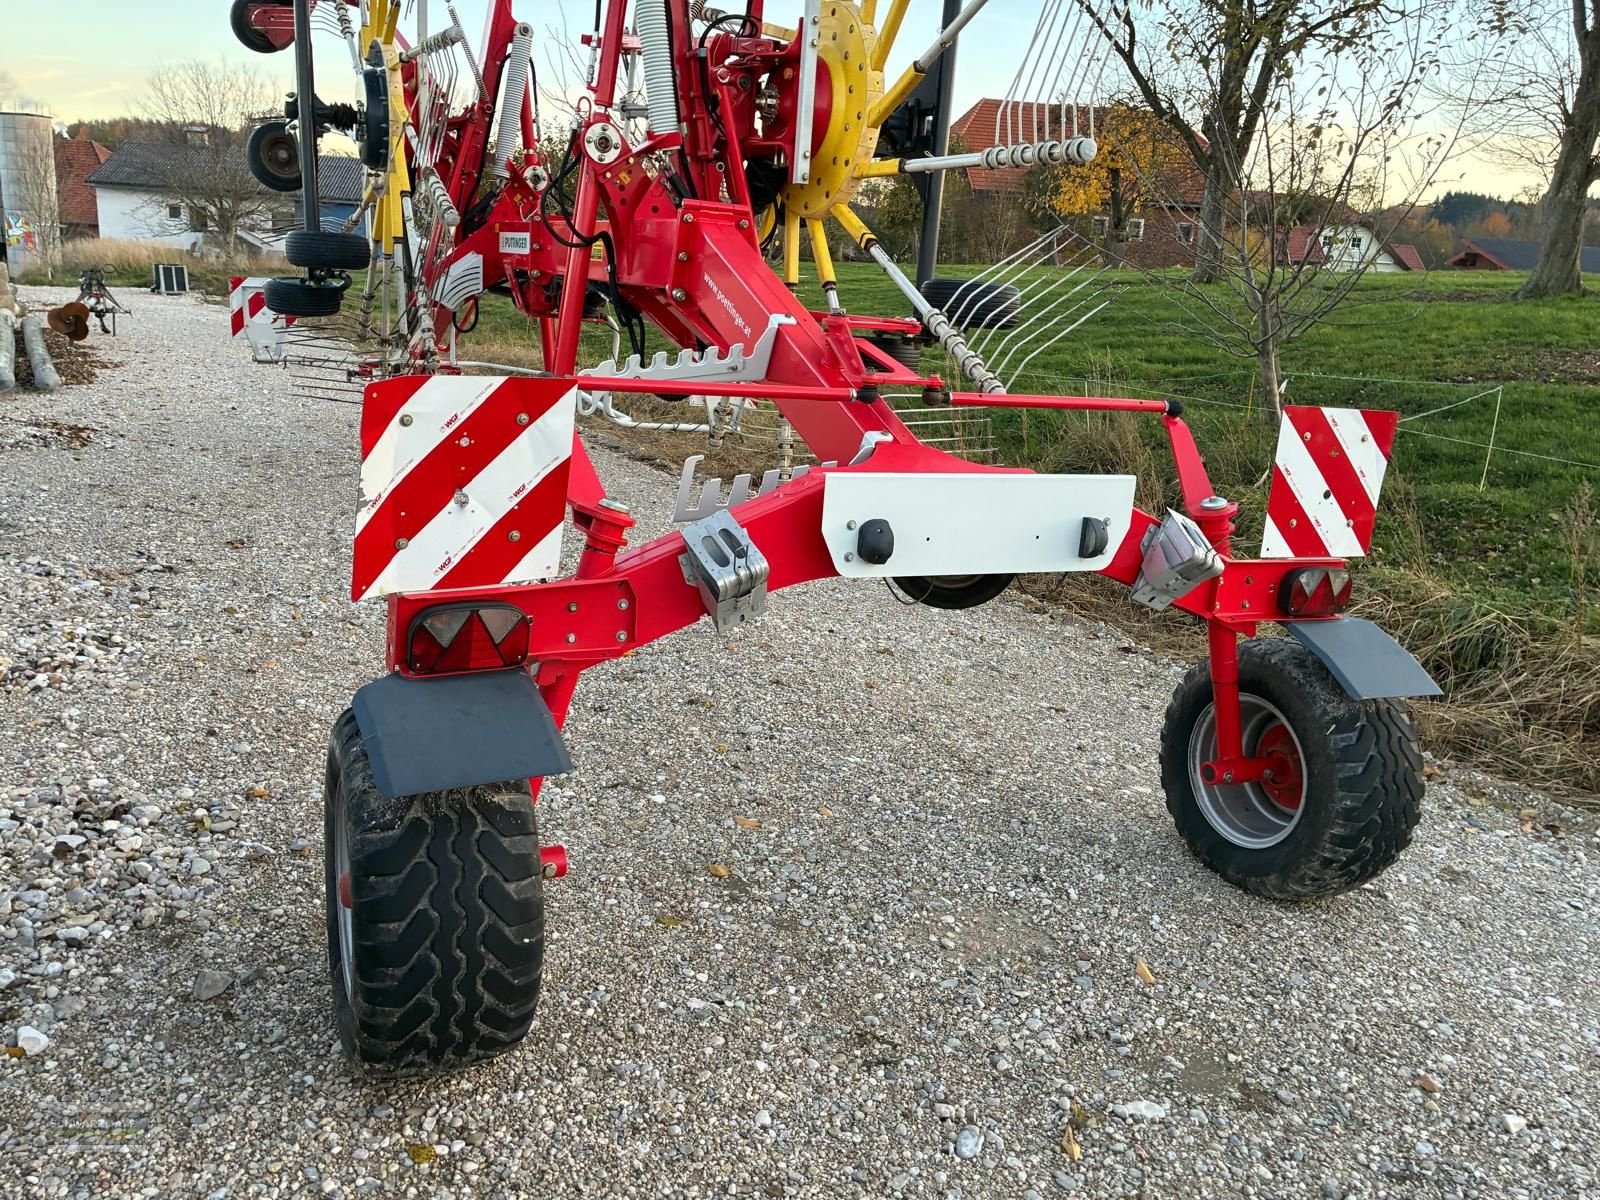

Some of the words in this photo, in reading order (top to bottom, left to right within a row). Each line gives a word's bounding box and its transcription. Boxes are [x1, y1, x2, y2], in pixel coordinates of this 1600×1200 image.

[704, 271, 751, 339] www.poettinger.at
[444, 412, 459, 428] WGF
[512, 483, 527, 498] WGF
[370, 491, 382, 508] WGF
[438, 556, 452, 571] WGF
